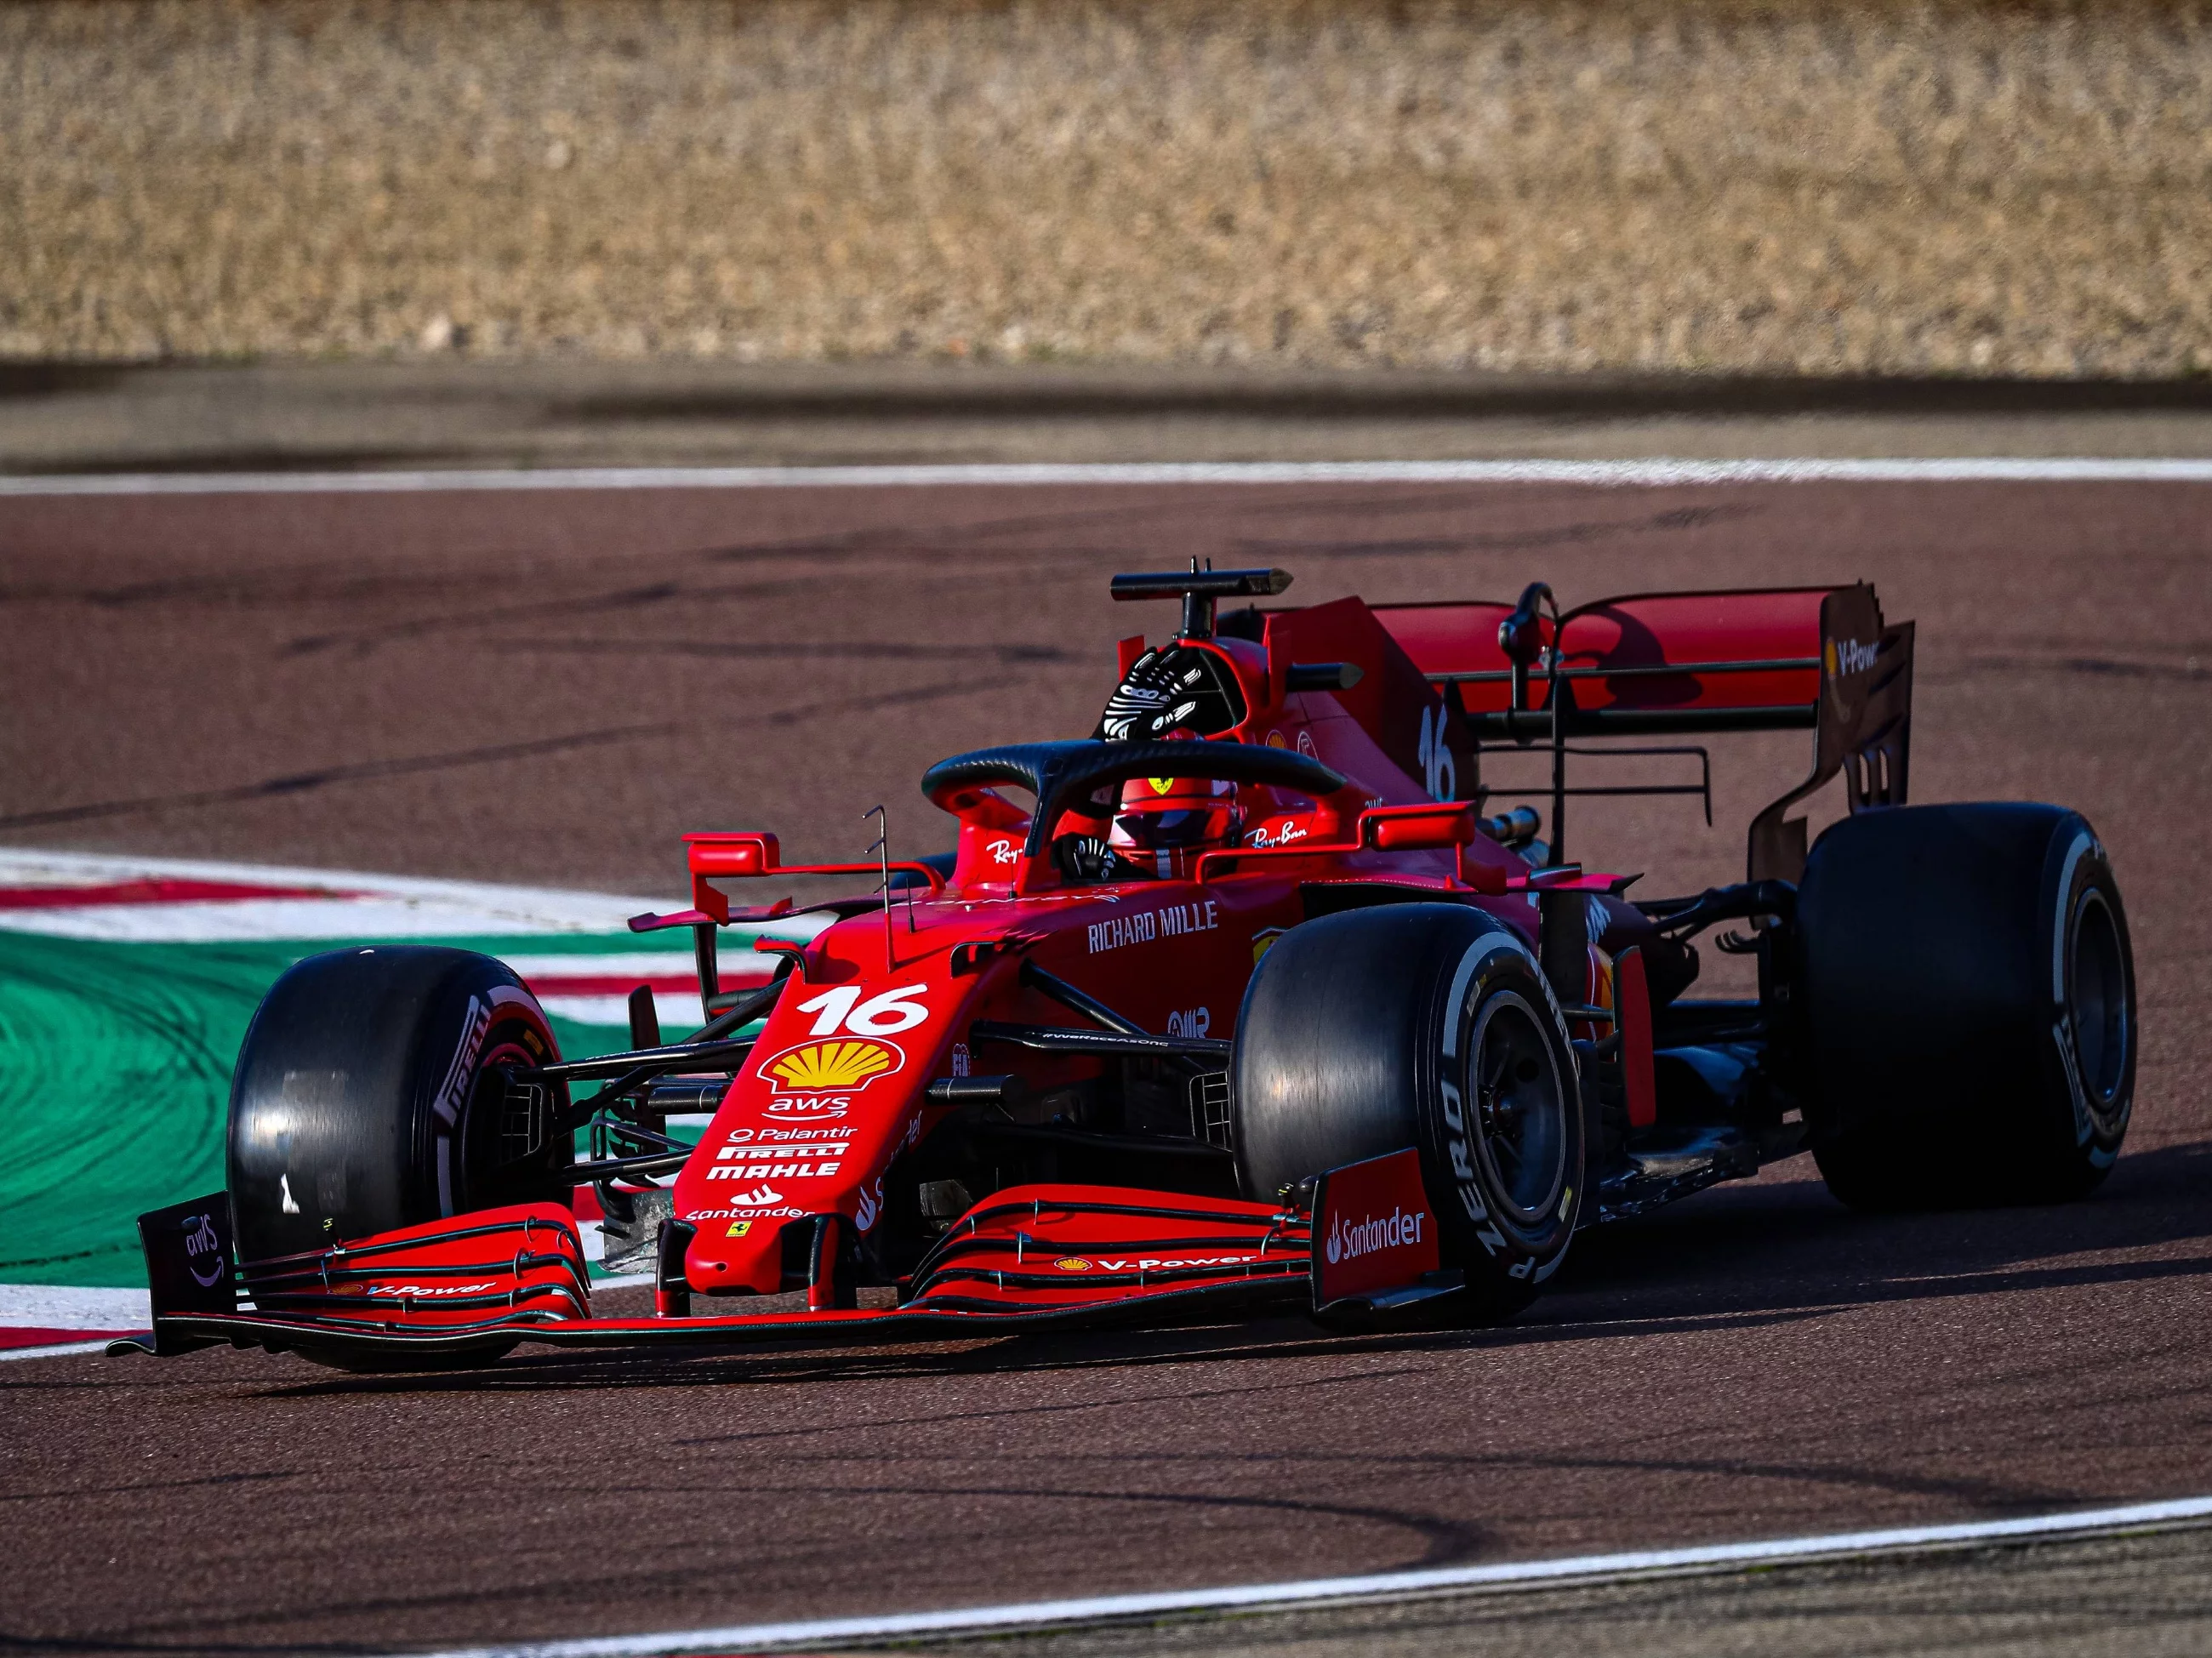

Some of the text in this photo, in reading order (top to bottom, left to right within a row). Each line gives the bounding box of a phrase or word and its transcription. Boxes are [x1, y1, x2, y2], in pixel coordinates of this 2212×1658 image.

[1417, 703, 1457, 802] 16
[1244, 821, 1308, 849] Ray-Ban
[1087, 900, 1218, 954] RICHARD MILLE
[796, 983, 929, 1036] 16
[433, 994, 491, 1129] PIRELLI
[768, 1097, 851, 1112] aws
[756, 1125, 858, 1142] Palantir
[715, 1142, 851, 1160] PIRELLI
[705, 1162, 841, 1180] MAHLE
[1440, 1076, 1508, 1258] ZERO
[1343, 1205, 1425, 1260] Santander
[1097, 1254, 1258, 1272] V-Power
[367, 1281, 498, 1296] V-Power
